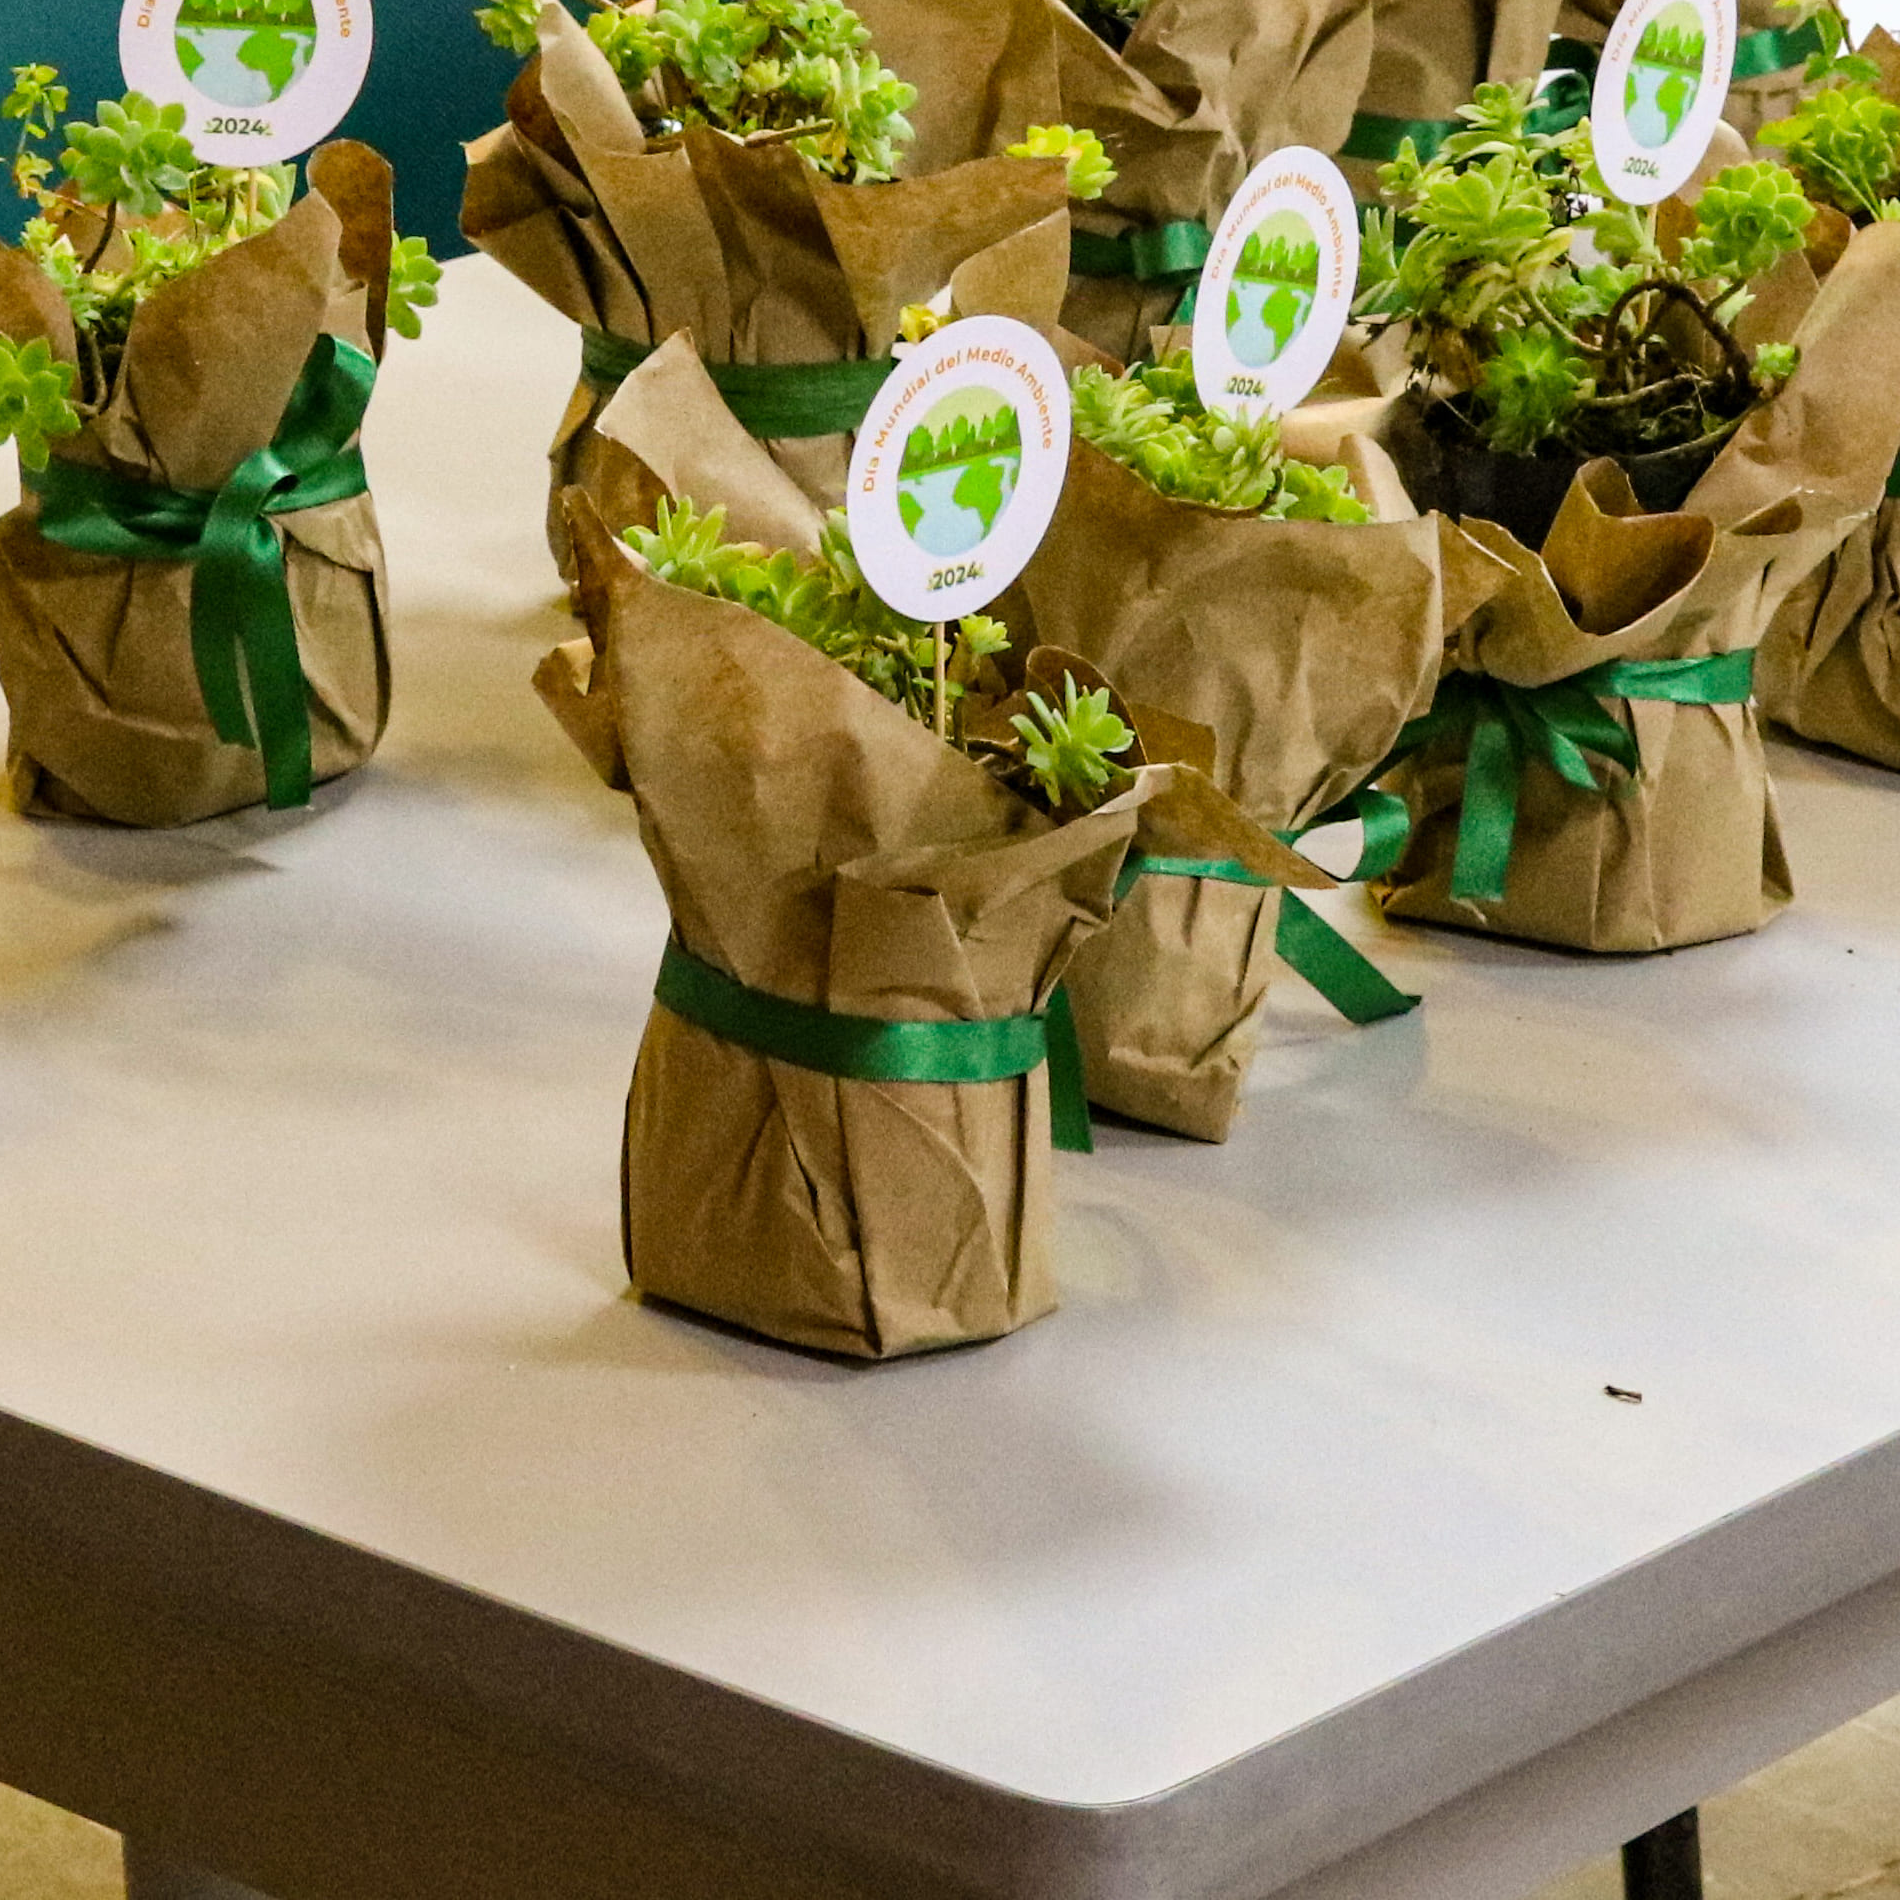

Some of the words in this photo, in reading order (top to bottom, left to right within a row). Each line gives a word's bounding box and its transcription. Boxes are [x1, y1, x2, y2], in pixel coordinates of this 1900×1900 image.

[212, 117, 265, 135] 2024
[1627, 156, 1656, 178] 2024
[1273, 172, 1294, 189] del
[1228, 376, 1262, 396] 2024
[863, 456, 881, 493] Día
[874, 369, 931, 448] Mundial
[935, 352, 961, 376] del
[967, 346, 1015, 369] Medio
[1014, 362, 1053, 450] Ambiente
[932, 560, 980, 590] 2024
